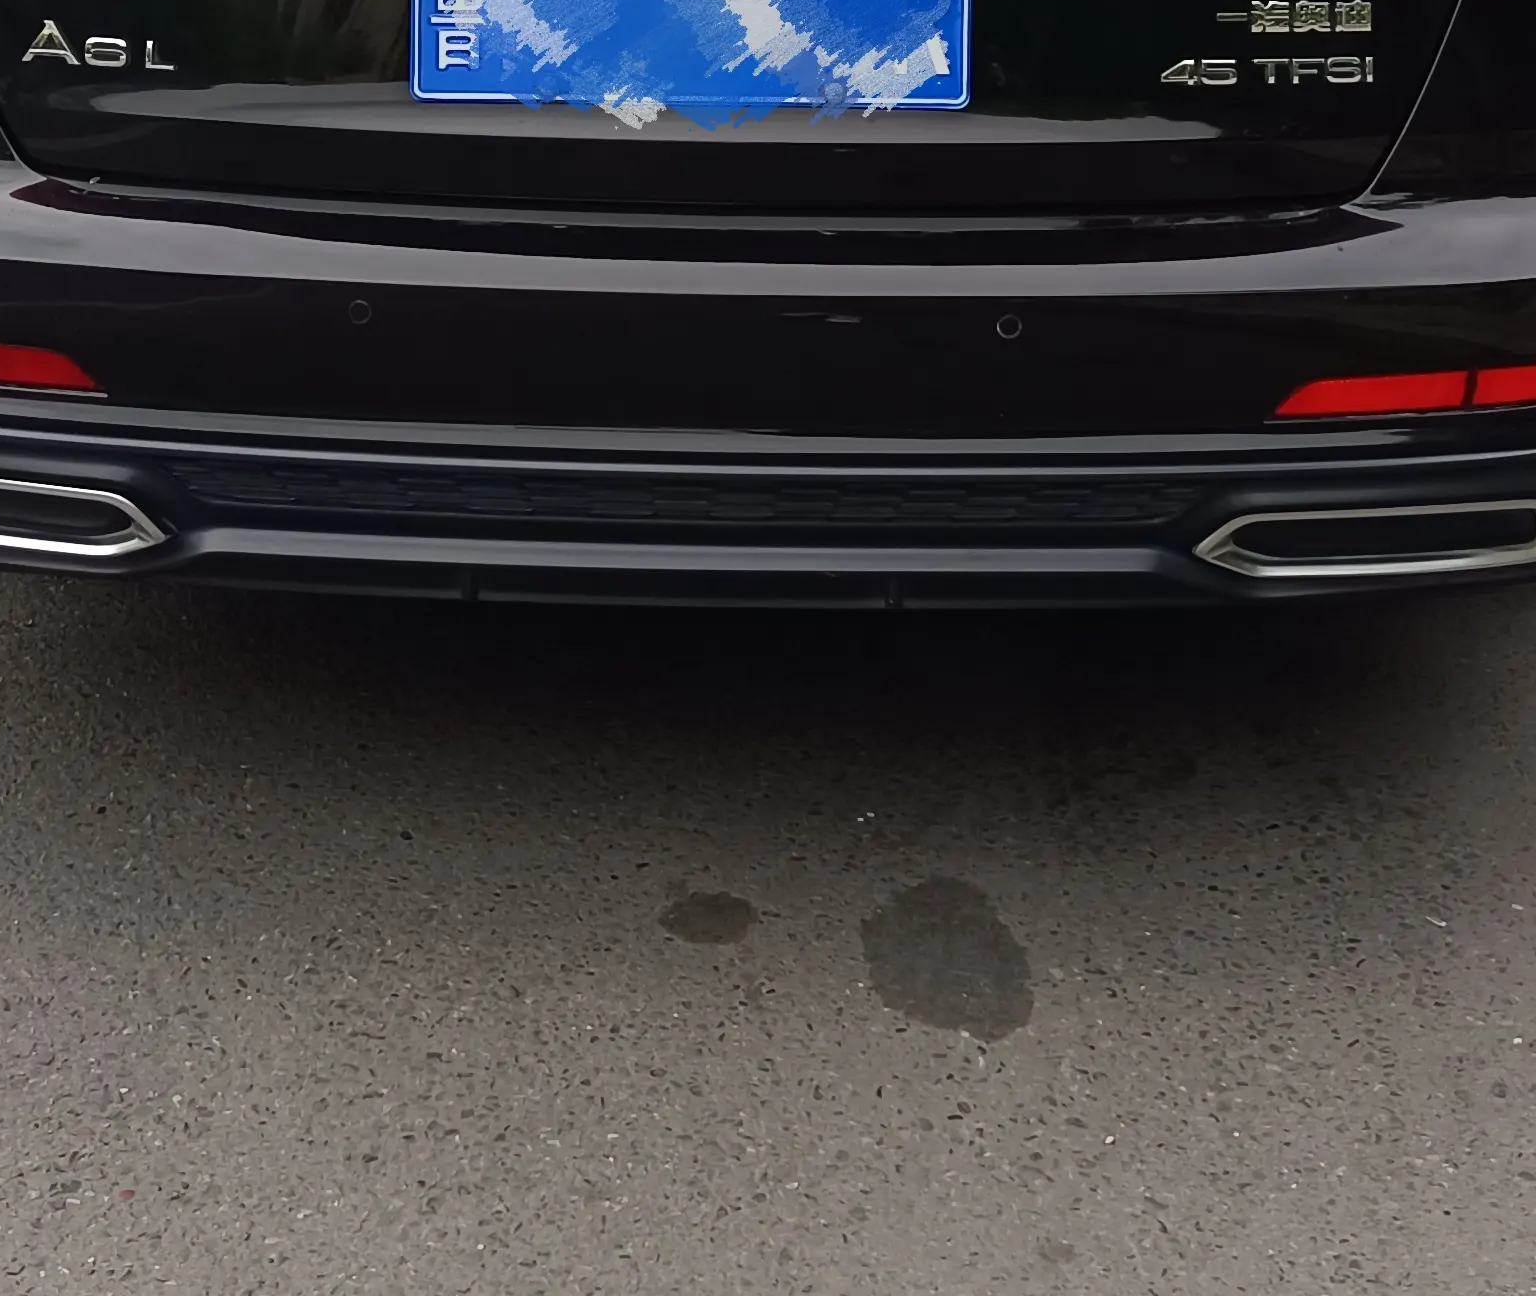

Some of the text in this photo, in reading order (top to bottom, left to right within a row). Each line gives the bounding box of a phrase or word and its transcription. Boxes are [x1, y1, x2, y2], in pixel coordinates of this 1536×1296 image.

[1216, 0, 1372, 32] 一汽奥迪
[1160, 56, 1374, 85] 45 TFSI
